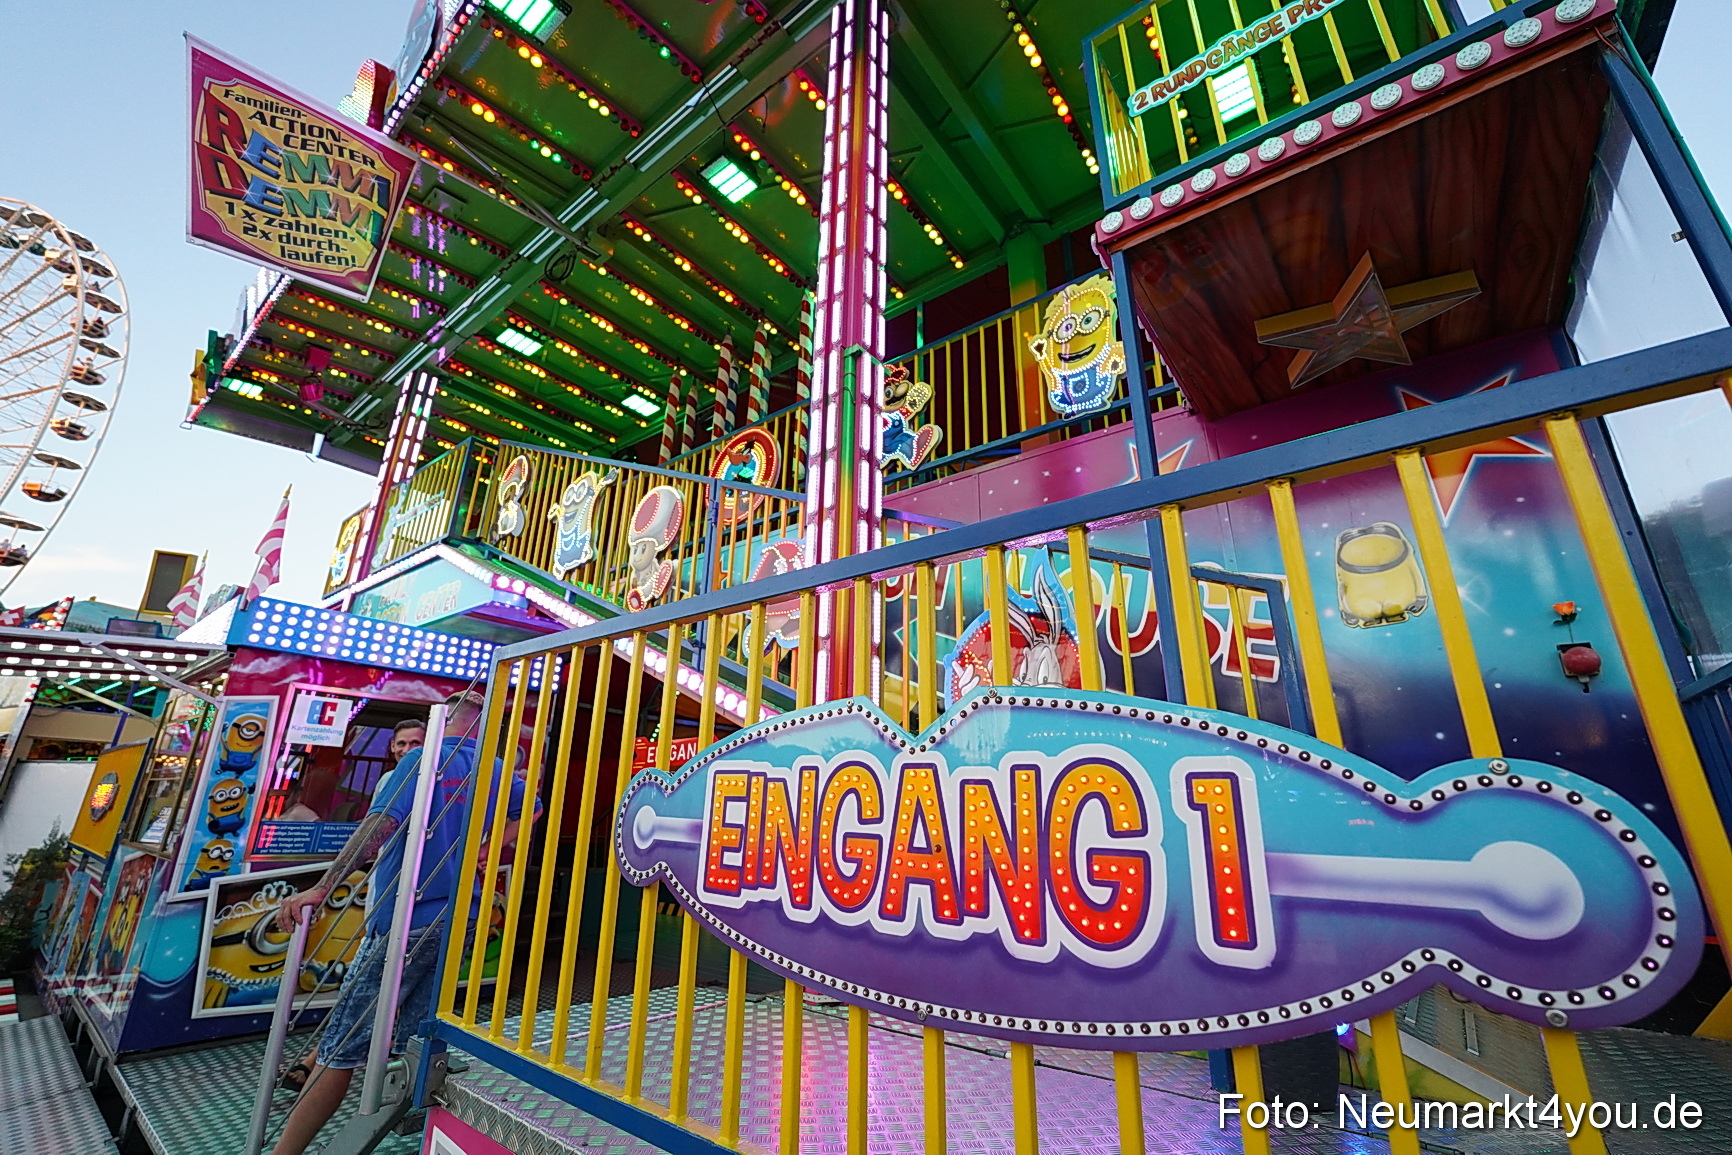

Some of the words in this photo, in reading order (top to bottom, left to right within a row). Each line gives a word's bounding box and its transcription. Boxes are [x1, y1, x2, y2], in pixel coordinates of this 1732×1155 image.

[1134, 92, 1149, 110] 2
[1151, 16, 1286, 102] RUNDGÄNGE
[223, 88, 308, 119] Familien-
[248, 110, 349, 144] ACTION-
[202, 88, 391, 213] REMMI
[283, 134, 377, 170] CENTER
[195, 141, 384, 251] DEMMI
[242, 221, 274, 242] 2x
[277, 232, 348, 253] durch-
[262, 215, 357, 243] zahlen,
[279, 245, 358, 268] laufen!
[291, 725, 344, 736] Kartenzahlung
[703, 757, 1150, 952] EINGANG
[1186, 771, 1258, 951] 1
